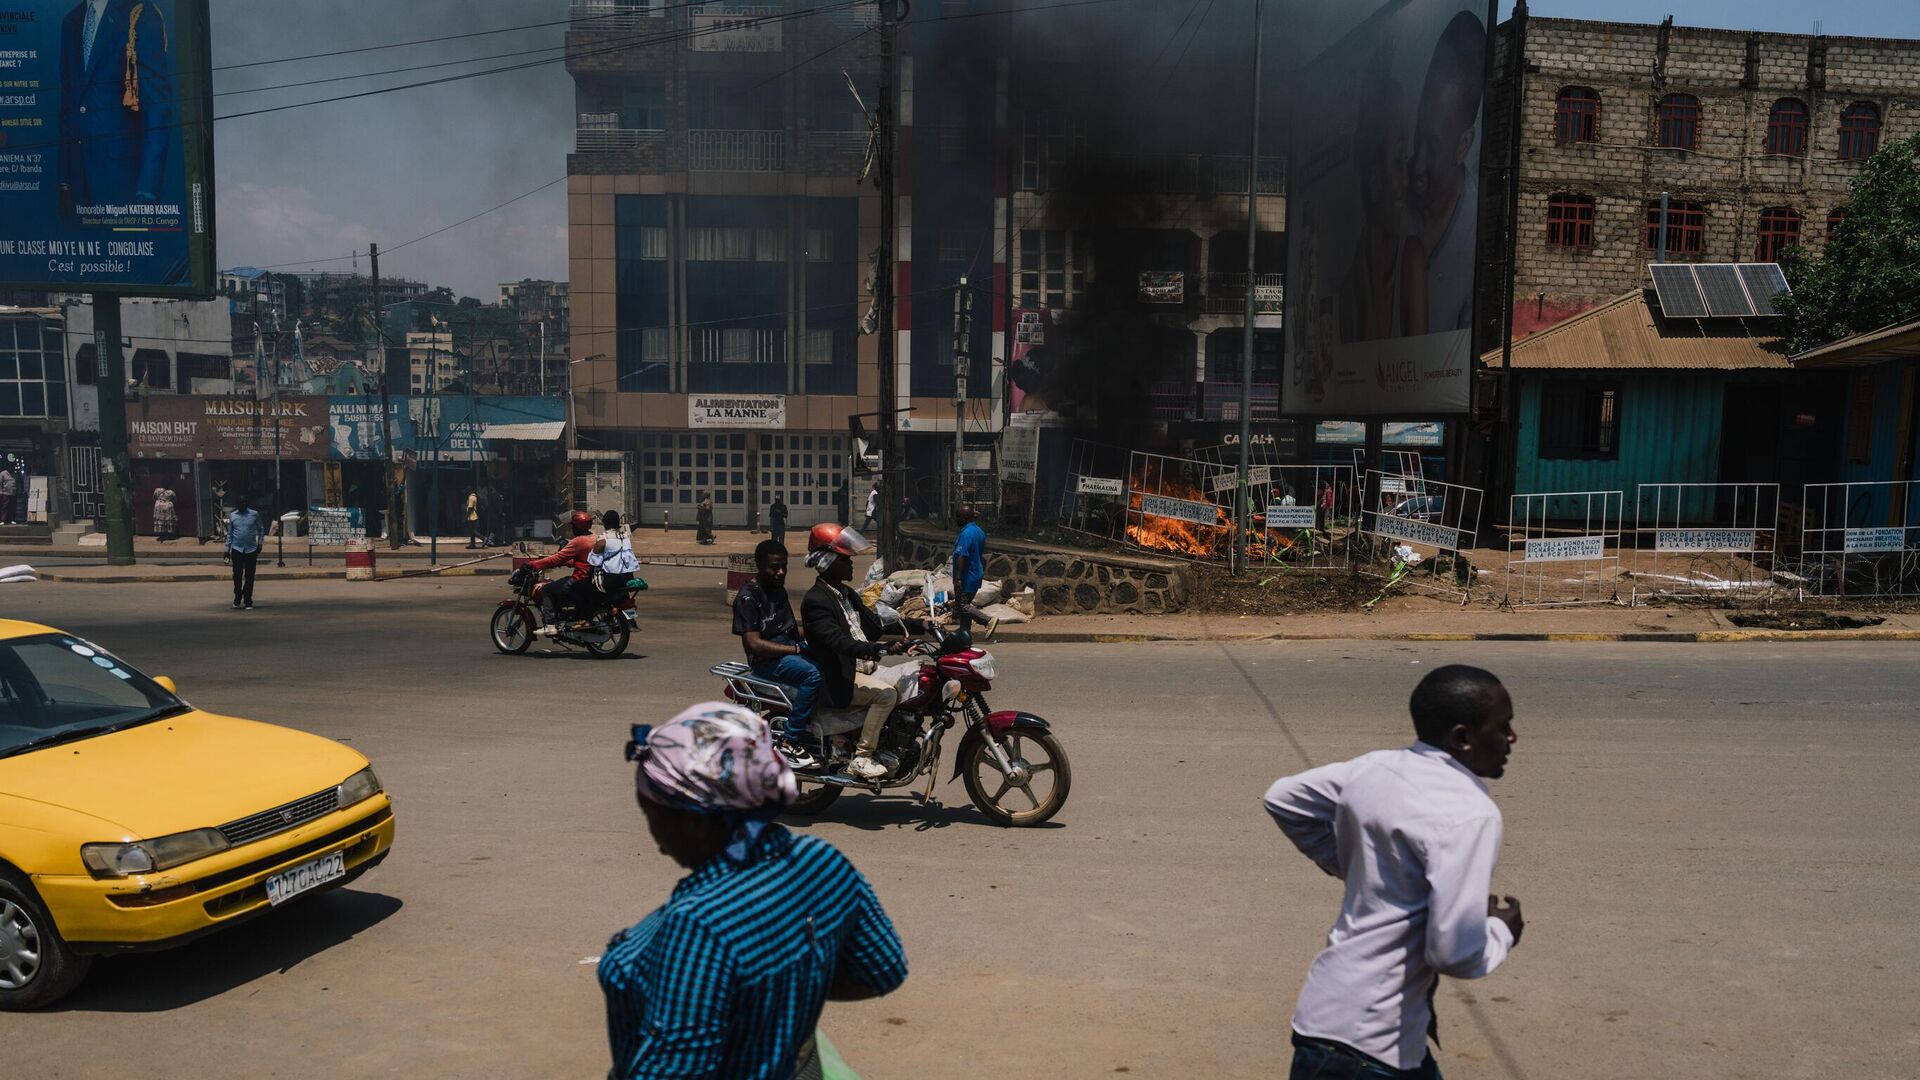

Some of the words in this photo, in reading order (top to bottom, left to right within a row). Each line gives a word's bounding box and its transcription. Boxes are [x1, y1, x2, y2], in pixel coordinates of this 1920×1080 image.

[713, 20, 762, 32] HOTEL
[29, 50, 37, 58] DE
[76, 204, 105, 215] Honorable
[105, 204, 128, 216] Miguel
[129, 204, 155, 215] KATEMB
[155, 204, 180, 215] KASHAL
[141, 217, 154, 225] R.D.
[155, 217, 179, 227] Congo
[18, 240, 46, 255] CLASSE
[49, 240, 102, 256] MOYENNE
[108, 241, 154, 256] CONGOLAISE
[80, 260, 124, 275] possible
[1386, 361, 1419, 383] ANGEL
[1446, 368, 1463, 378] BEAUTY
[205, 400, 264, 416] MAISON
[329, 404, 354, 414] AKILI
[695, 399, 779, 409] ALIMENTATION
[345, 414, 384, 422] BUSINESS
[706, 409, 722, 418] LA
[724, 409, 767, 418] MANNE
[131, 420, 171, 434] MAISON
[174, 420, 198, 434] BHT
[1224, 434, 1274, 445] CAAL+
[1082, 484, 1118, 492] PHARMAKINA
[1379, 522, 1407, 532] RICHARD
[1380, 517, 1393, 525] DON
[1418, 524, 1456, 537] FONDATION
[1564, 539, 1600, 547] FONDATION
